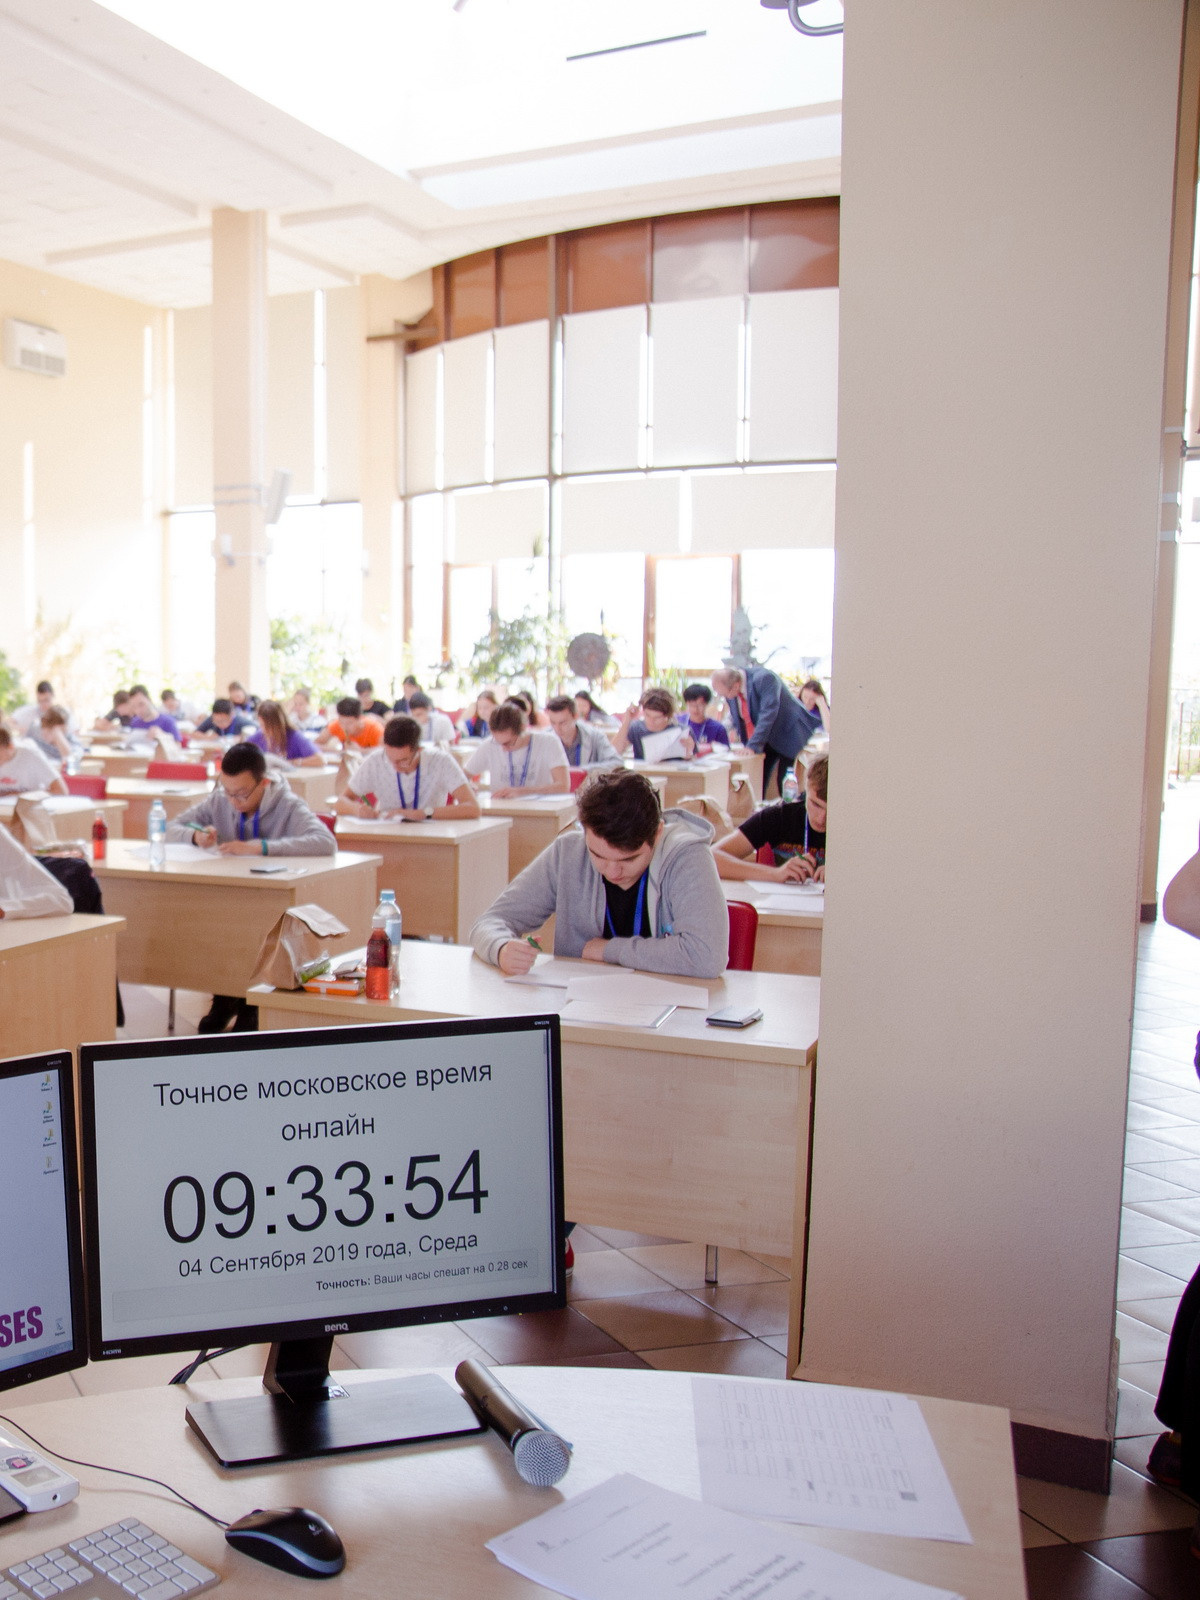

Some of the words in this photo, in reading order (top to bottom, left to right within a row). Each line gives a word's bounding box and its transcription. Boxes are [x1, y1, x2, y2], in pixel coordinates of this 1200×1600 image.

[152, 1082, 249, 1107] Точное
[257, 1070, 407, 1100] московское
[415, 1064, 492, 1092] время
[281, 1112, 376, 1142] онлайн
[163, 1149, 489, 1245] 09:33:54
[178, 1258, 203, 1278] 04
[209, 1249, 306, 1275] Сентября
[312, 1243, 359, 1265] 2019
[365, 1241, 413, 1261] года,
[418, 1234, 479, 1256] Среда
[315, 1278, 371, 1291] Точность:
[373, 1273, 403, 1285] Ваши
[405, 1271, 431, 1281] часы
[433, 1266, 471, 1280] спешат
[473, 1264, 486, 1274] на
[487, 1259, 510, 1273] 0.28
[511, 1259, 529, 1271] сек
